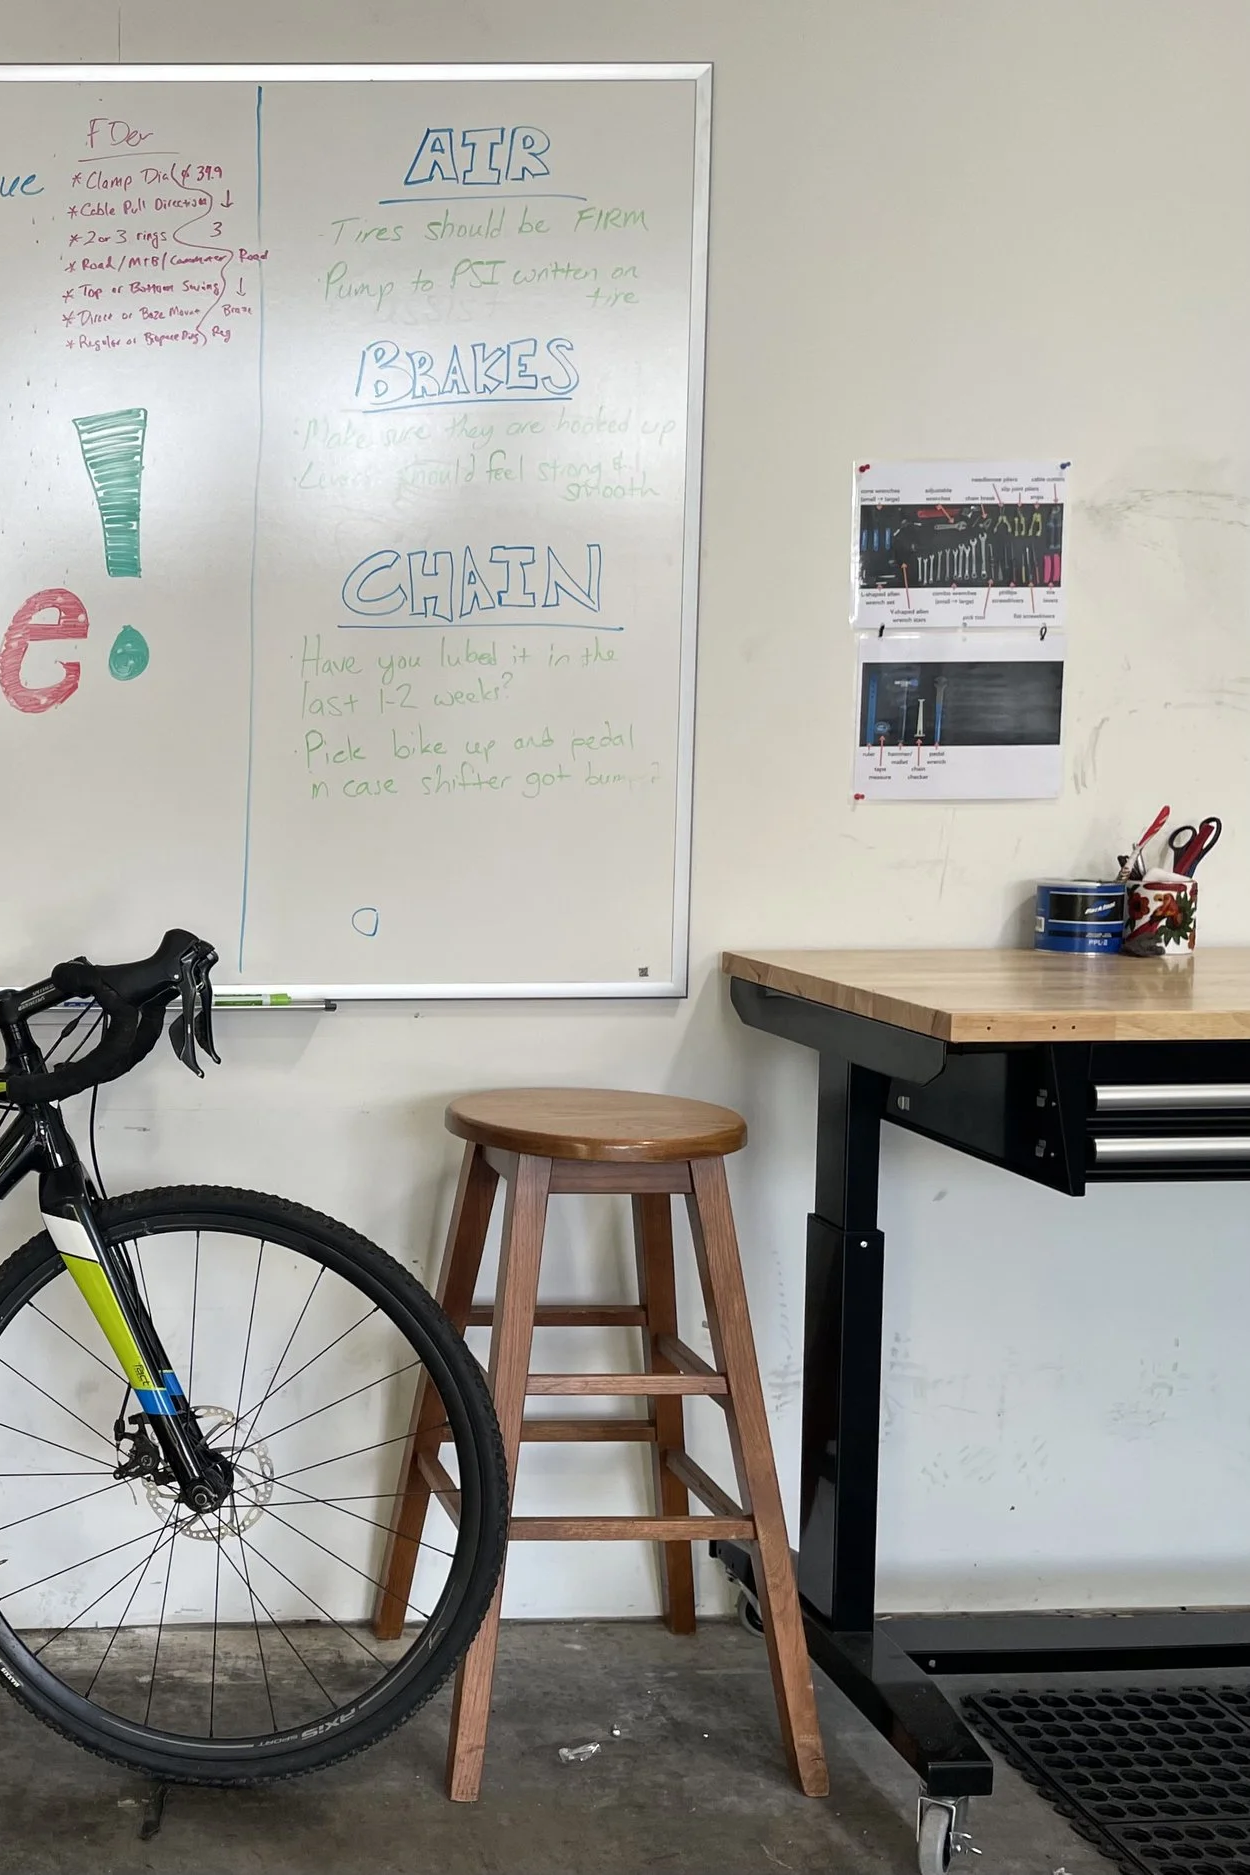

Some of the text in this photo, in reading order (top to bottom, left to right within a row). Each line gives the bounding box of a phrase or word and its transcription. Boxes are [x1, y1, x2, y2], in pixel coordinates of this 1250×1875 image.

[403, 126, 551, 186] AIR
[86, 171, 133, 191] Clamp
[80, 198, 208, 217] Cable Pull Direction
[210, 221, 223, 237] 3
[330, 207, 650, 245] Tires should be FIRM
[83, 231, 97, 246] 2
[116, 230, 127, 244] 3
[136, 232, 167, 249] rings
[239, 248, 269, 263] Road
[78, 280, 220, 299] Top or Bottom Swing
[324, 261, 395, 312] Pump
[412, 269, 434, 293] to
[450, 258, 507, 289] PSI
[512, 262, 599, 285] written
[610, 265, 639, 280] on
[585, 286, 640, 307] tire
[78, 310, 113, 326] Direct
[121, 311, 134, 320] or
[78, 335, 121, 351] Regular
[211, 325, 232, 344] Reg
[354, 337, 580, 406] BRAKES
[382, 426, 432, 446] sure
[445, 415, 494, 450] they
[506, 420, 544, 435] are
[556, 406, 629, 437] hooked
[641, 420, 677, 446] up
[485, 448, 524, 483] feel
[536, 456, 602, 483] strong
[565, 478, 661, 501] smooth
[341, 543, 602, 622] CHAIN
[300, 633, 619, 685] Have you lubed it in the
[301, 671, 514, 719] last 1-2 weeks?
[304, 720, 635, 768] Pick bike up and pedal
[342, 778, 399, 797] case
[421, 763, 512, 797] shifter
[525, 763, 572, 799] got
[0, 1666, 20, 1688] MAXXIS
